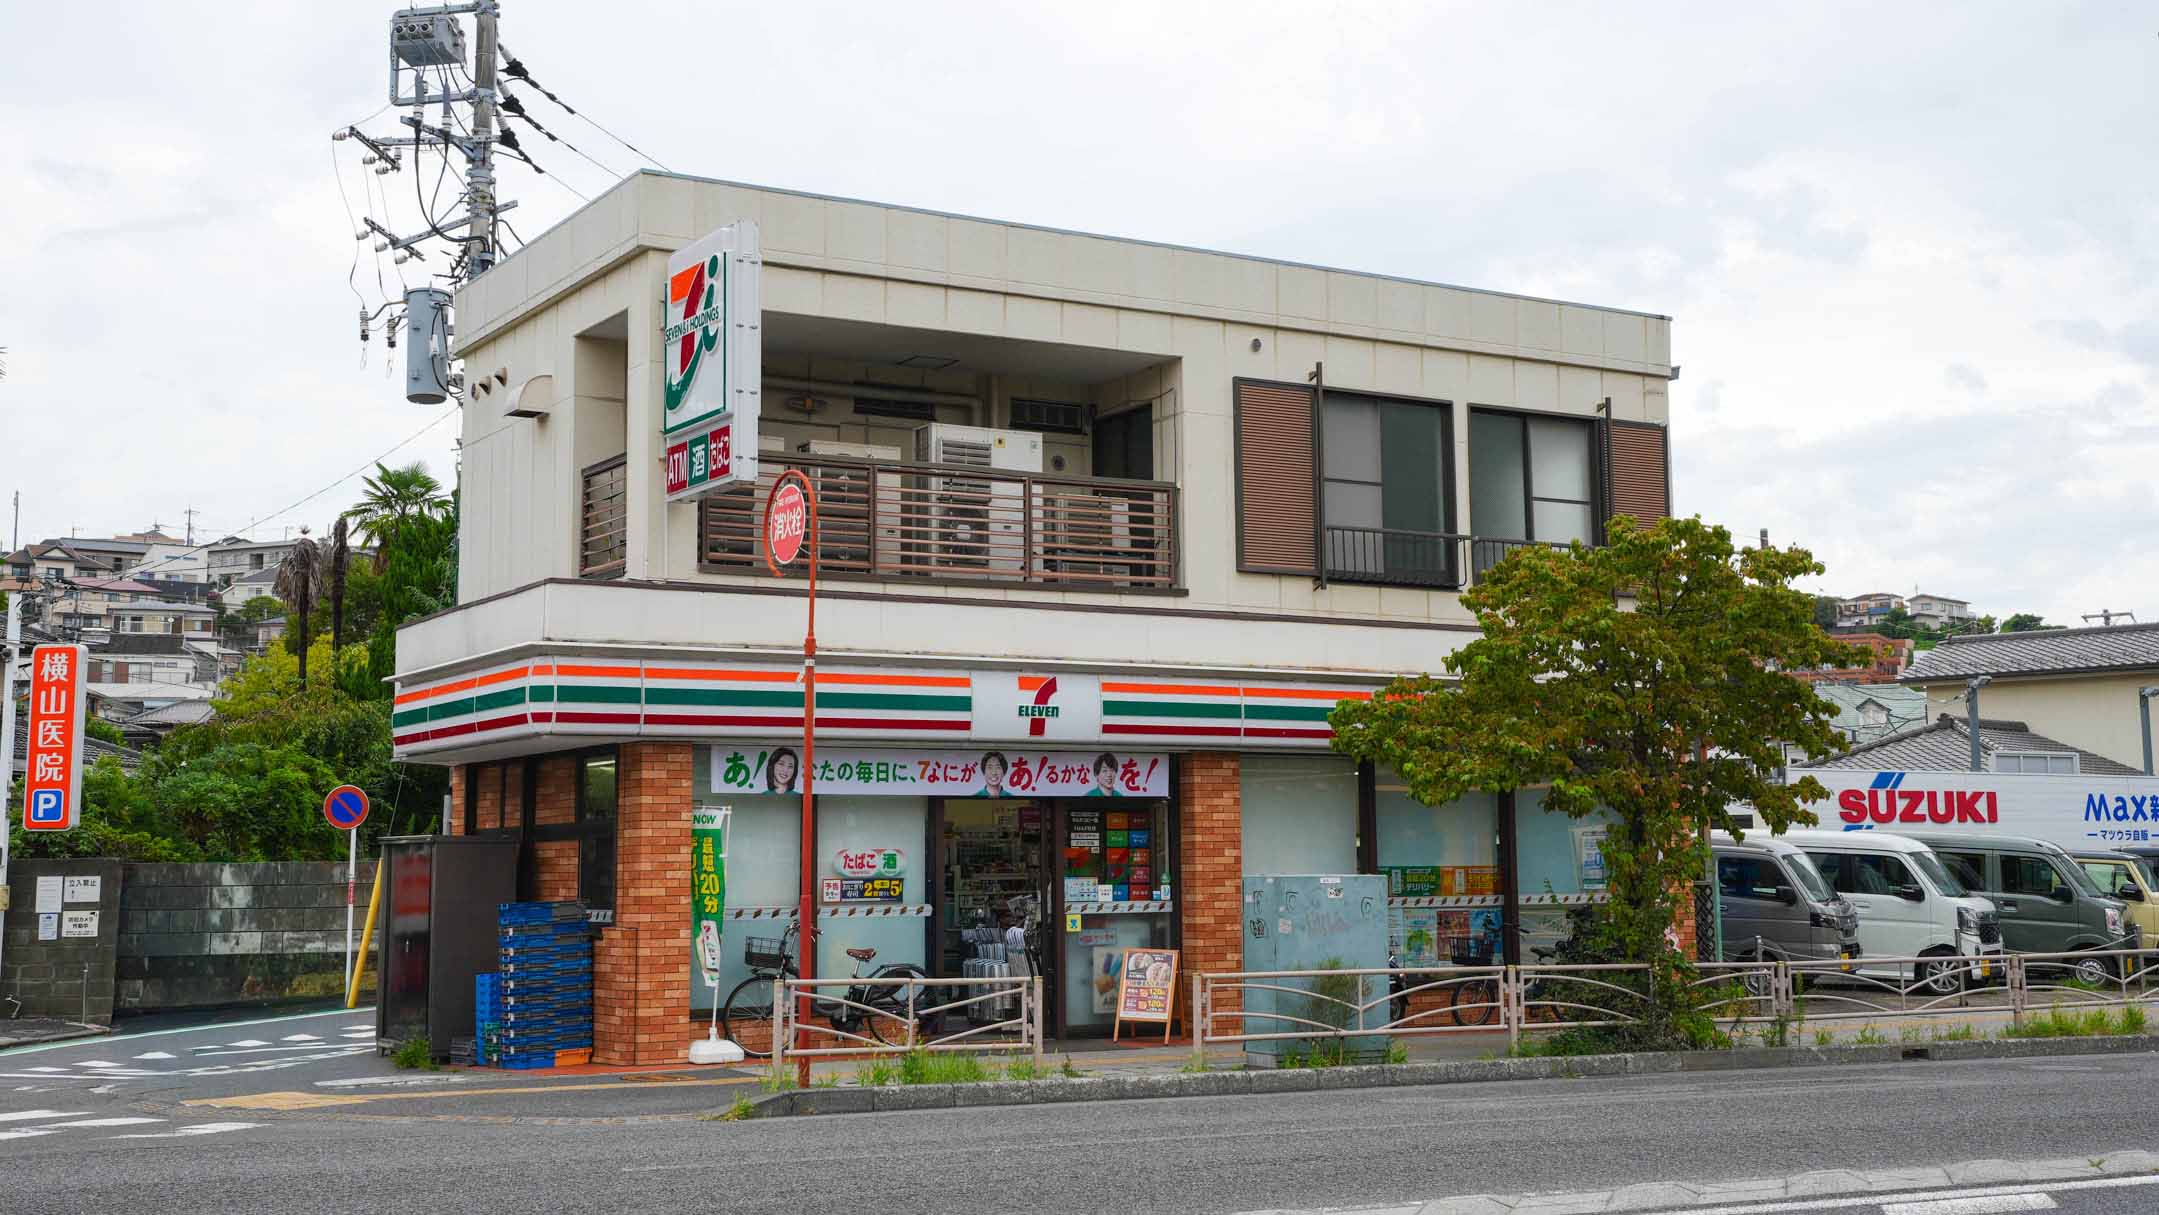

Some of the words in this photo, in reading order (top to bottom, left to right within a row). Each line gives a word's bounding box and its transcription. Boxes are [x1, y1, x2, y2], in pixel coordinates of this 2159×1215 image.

[668, 450, 687, 486] ATM
[692, 444, 705, 479] 酒
[710, 435, 730, 470] たばこ
[774, 506, 802, 542] 消火栓
[35, 653, 69, 783] 横山医院
[37, 793, 57, 818] P
[1839, 789, 1998, 824] SUZUKI
[843, 853, 877, 869] たばこ
[883, 853, 897, 869] 酒
